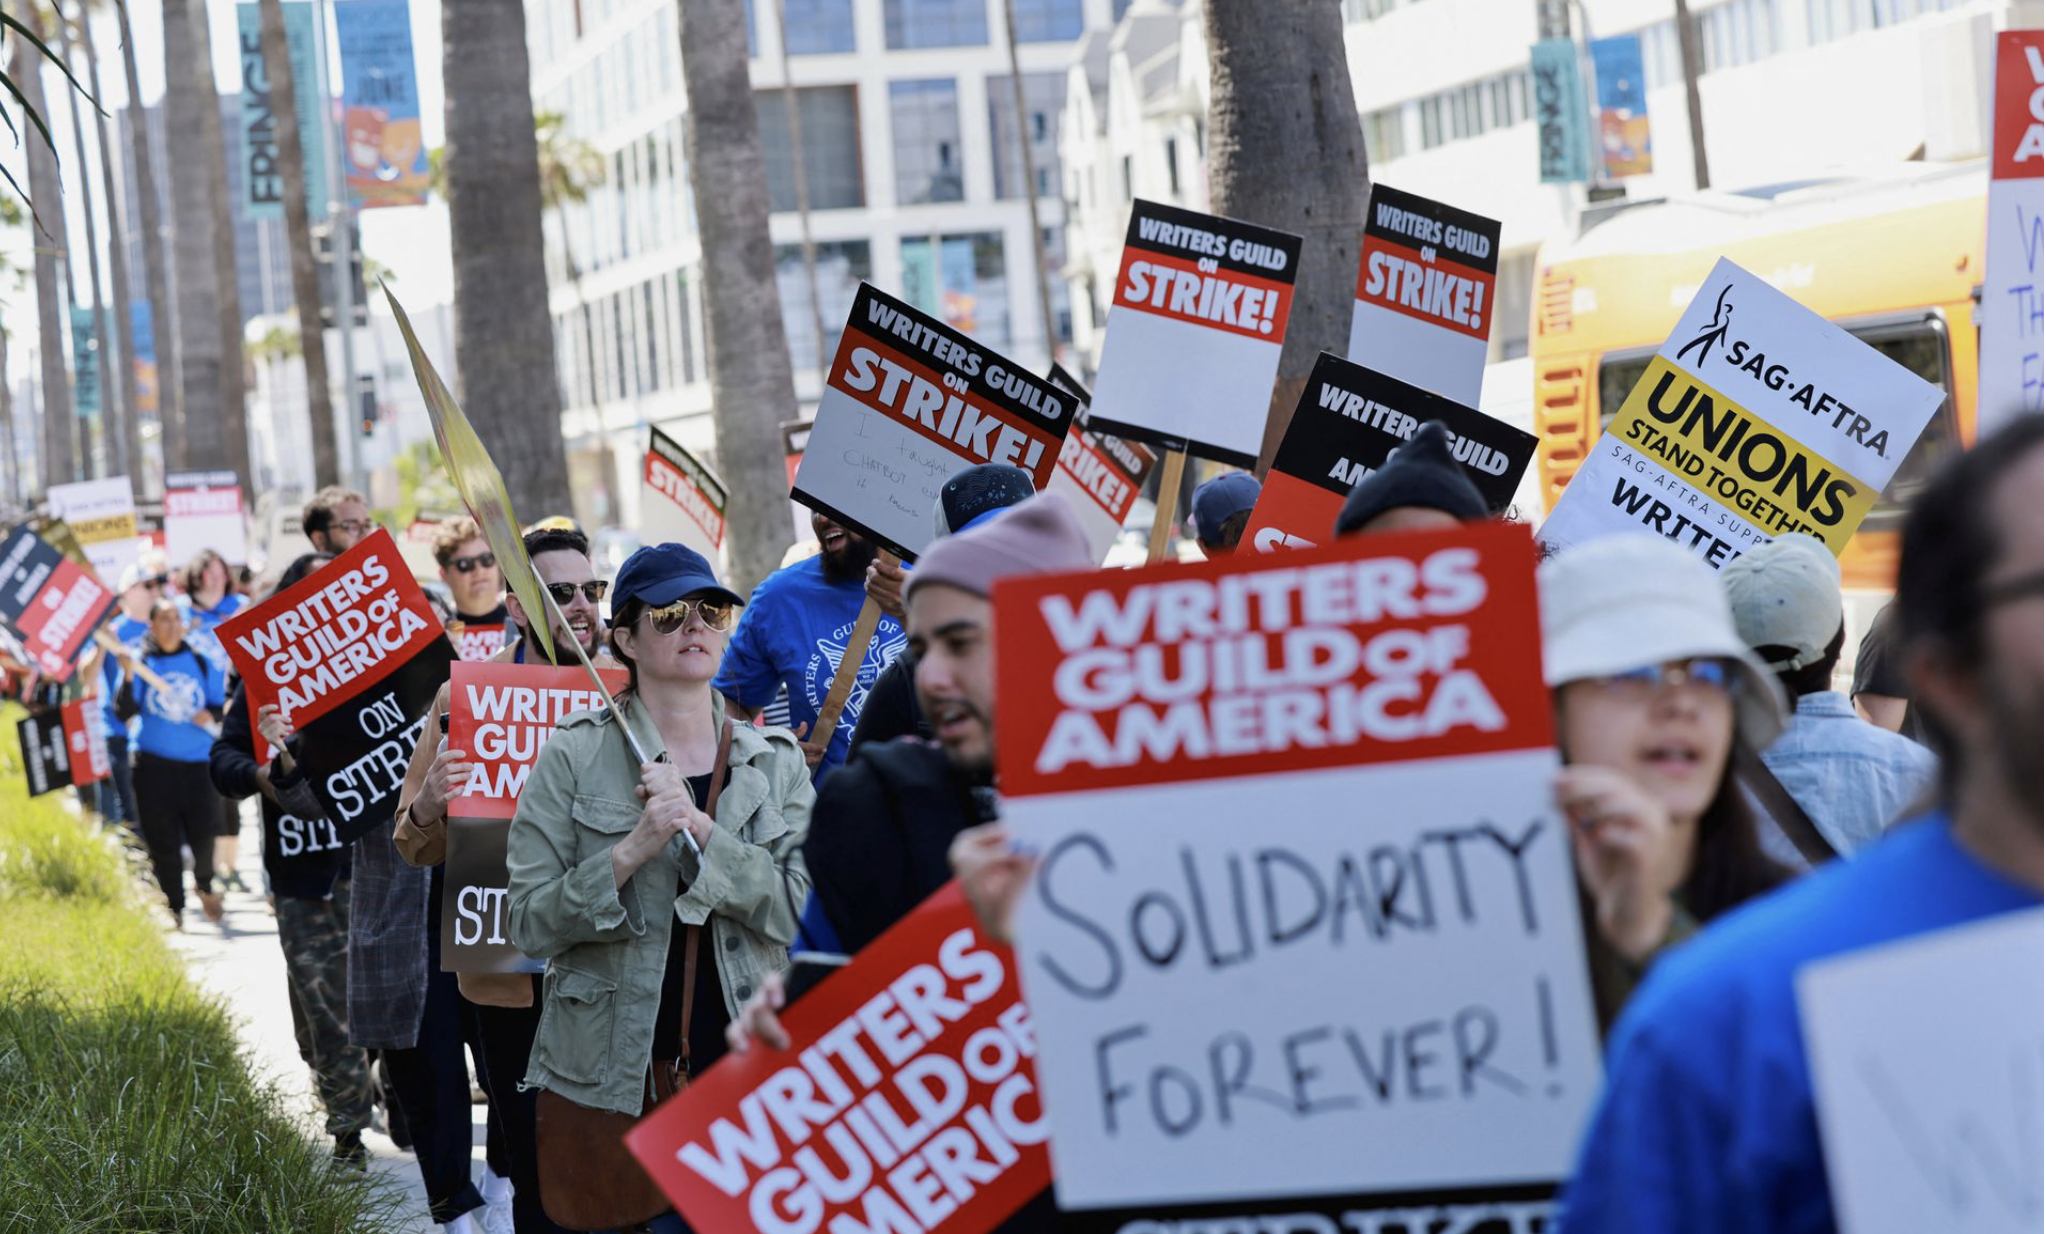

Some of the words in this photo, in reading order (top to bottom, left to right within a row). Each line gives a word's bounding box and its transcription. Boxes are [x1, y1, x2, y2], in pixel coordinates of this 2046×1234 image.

[1138, 215, 1228, 258] WRITERS
[1228, 239, 1287, 271] GUILD
[1197, 257, 1218, 274] ON
[1377, 202, 1443, 244] WRITERS
[1444, 225, 1490, 259] GUILD
[1420, 246, 1437, 263] ON
[1124, 260, 1279, 334] STRIKE!
[1365, 250, 1485, 330] STRIKE!
[867, 299, 982, 377] WRITERS
[984, 364, 1062, 420] GUILD
[942, 372, 970, 395] ON
[843, 346, 1045, 480] STRIKE!
[1626, 419, 1704, 477] STAND
[1647, 369, 1857, 526] UNIONS
[843, 449, 907, 484] CHATBOT
[1059, 436, 1131, 515] RIKE!
[1103, 434, 1143, 475] GUILD
[1611, 445, 1710, 516] SAG-AFTRA
[1717, 513, 1764, 546] SUPP
[650, 459, 721, 541] STRIKE!
[235, 554, 390, 662] WRITERS
[264, 611, 370, 686] GUILD
[367, 588, 401, 625] OF
[879, 620, 899, 634] OF
[1038, 547, 1488, 653] WRITERS
[277, 609, 428, 719] AMERICA
[1053, 627, 1362, 711] GUILD
[1363, 623, 1469, 677] OF
[359, 692, 406, 739] ON
[1035, 669, 1507, 773] AMERICA
[675, 927, 1004, 1198] WRITERS
[748, 1053, 968, 1234] GUILD
[962, 1001, 1037, 1083] OF
[827, 1073, 1055, 1234] MERIC
